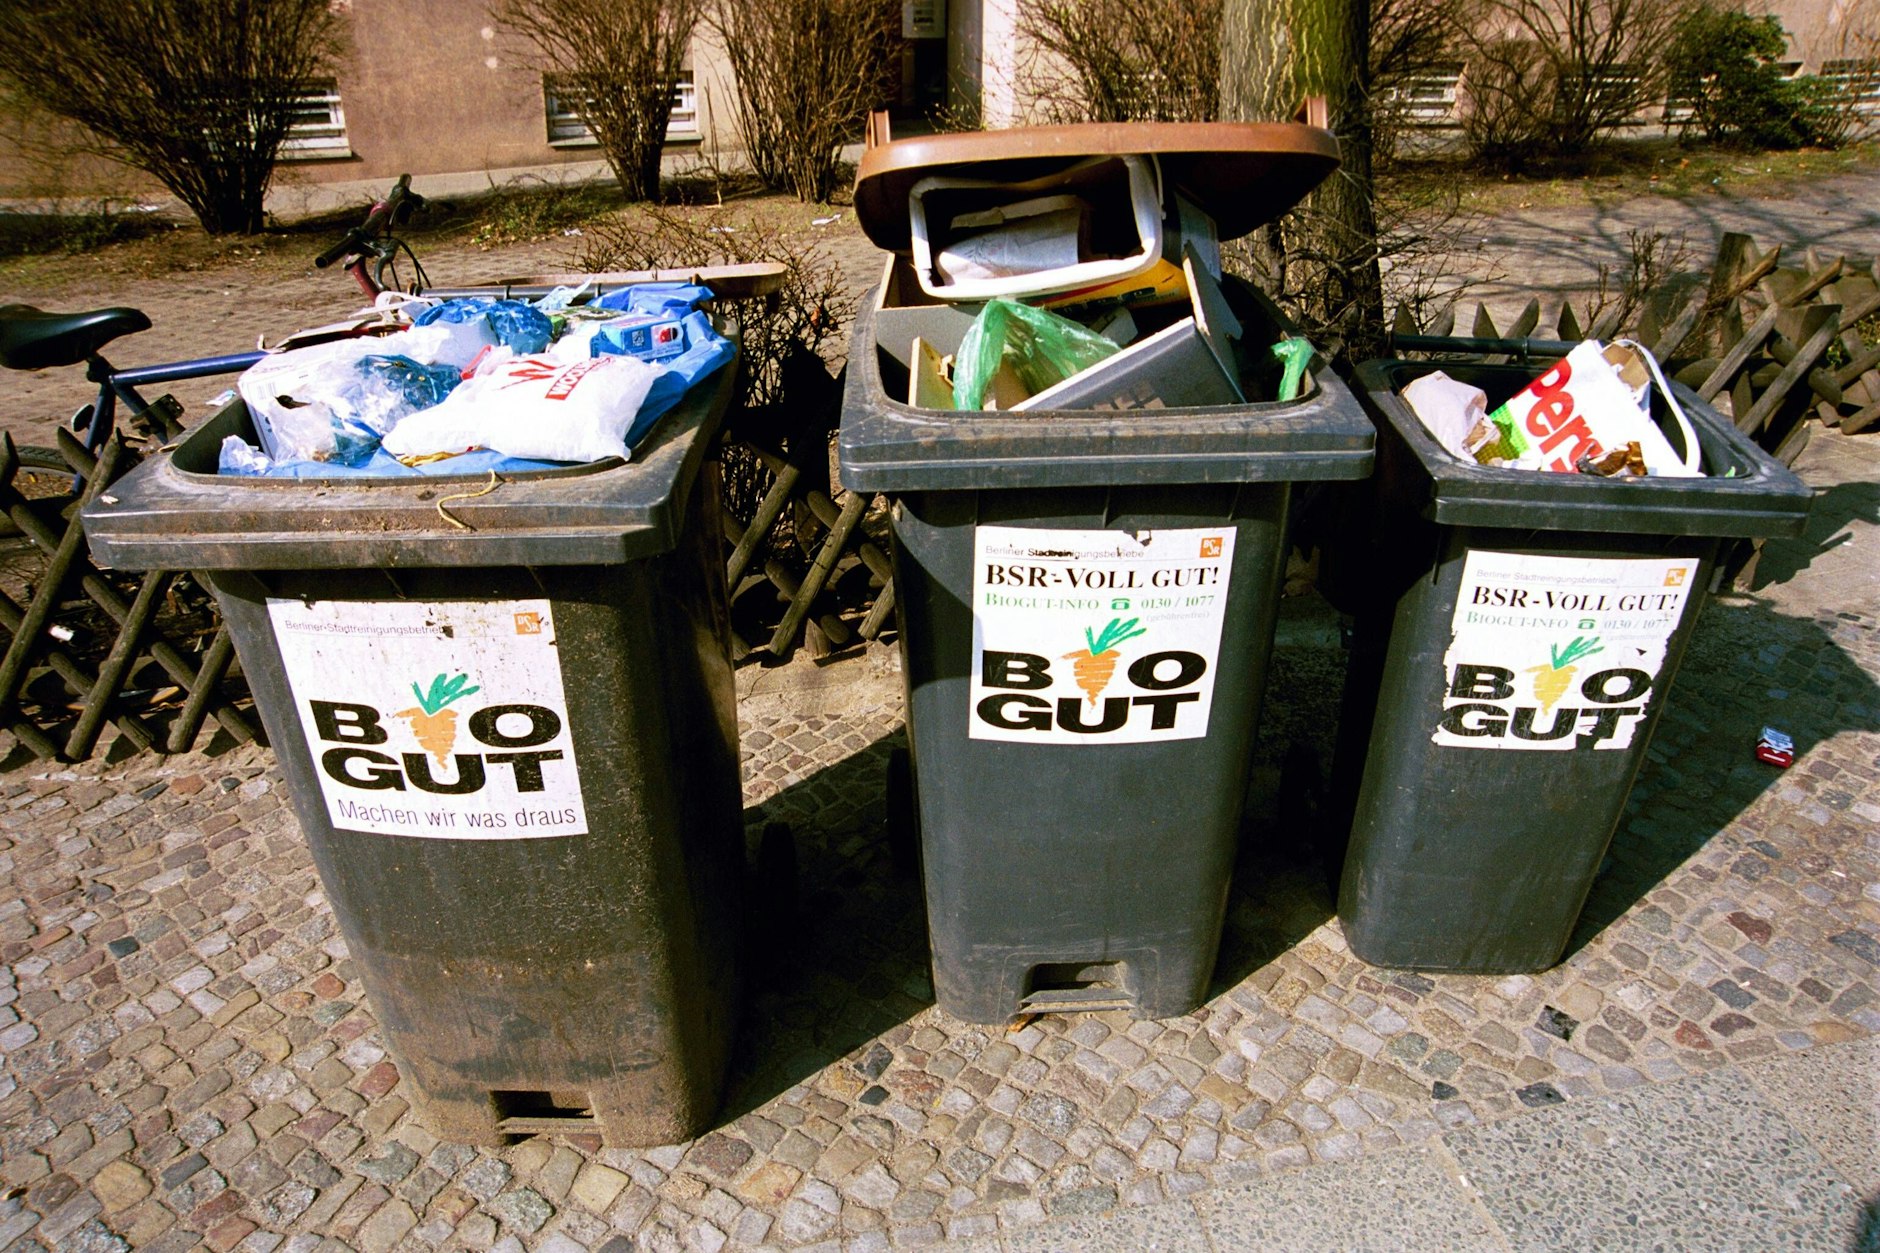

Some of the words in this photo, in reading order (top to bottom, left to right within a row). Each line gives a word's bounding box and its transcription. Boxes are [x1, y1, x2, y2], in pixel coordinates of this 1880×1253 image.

[985, 545, 1025, 557] Berliner
[1151, 567, 1219, 588] GUT!
[1476, 569, 1512, 580] Berliner
[1514, 572, 1617, 586] Stadtreinigungsbetriebe
[985, 592, 1099, 610] BIOGUT-INFO
[1140, 597, 1171, 609] 0130
[1184, 594, 1215, 607] 1077
[1618, 594, 1679, 612] GUT!
[285, 620, 324, 632] Berliner
[1466, 611, 1568, 629] BIOGUT-INFO
[1603, 620, 1631, 630] 0130
[976, 692, 1200, 734] GUT
[1440, 702, 1641, 741] GUT
[321, 747, 564, 795] GUT
[338, 799, 419, 826] Machen
[425, 808, 456, 827] wir
[467, 811, 508, 828] was
[515, 806, 577, 827] draus
